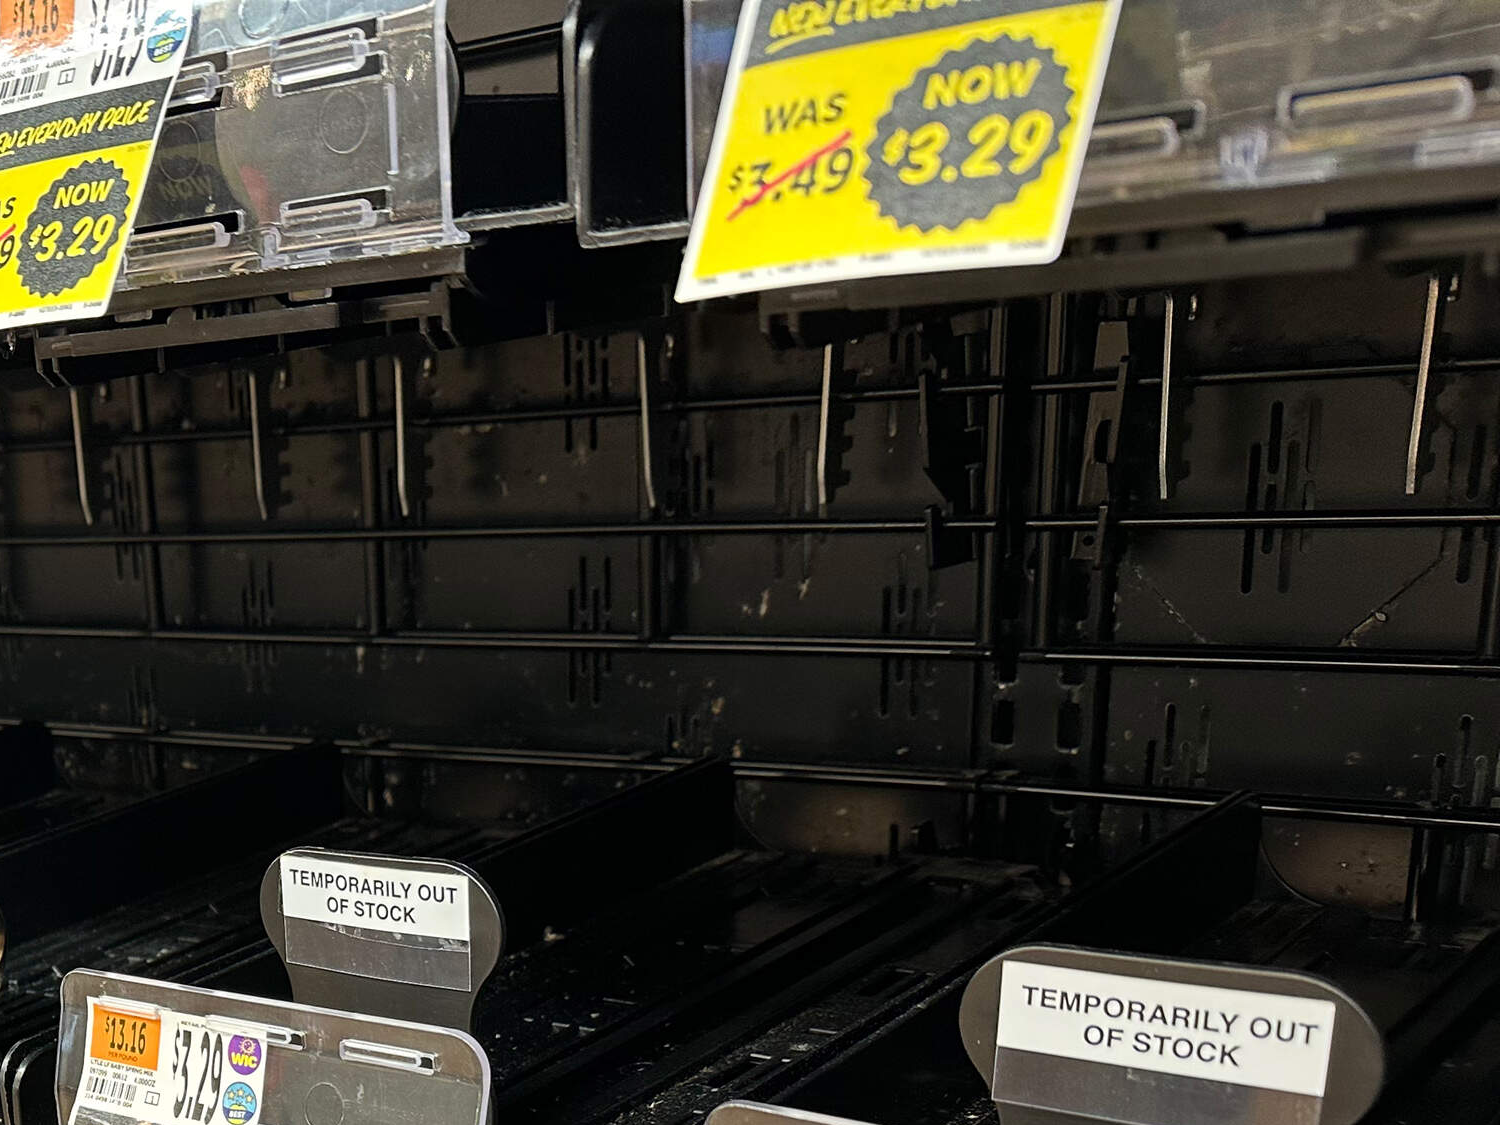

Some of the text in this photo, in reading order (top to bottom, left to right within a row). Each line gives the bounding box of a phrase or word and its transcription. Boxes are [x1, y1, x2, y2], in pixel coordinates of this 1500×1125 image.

[924, 57, 1043, 110] NOW
[18, 110, 102, 147] EVERYDAY
[98, 99, 156, 131] PRICE
[764, 93, 847, 135] WAS
[882, 110, 1055, 186] $3.29
[53, 178, 115, 210] NOW
[728, 147, 853, 207] $3.49
[29, 213, 116, 263] $3.29
[289, 868, 458, 905] TEMPORARILY OUT
[327, 897, 417, 924] OF STOCK
[105, 1015, 148, 1055] $13.16
[1021, 985, 1320, 1046] TEMPORARILY OUT
[231, 1051, 258, 1069] WIC
[1083, 1024, 1241, 1067] OF STOCK
[172, 1022, 224, 1125] $3.29
[228, 1110, 246, 1120] BEST
